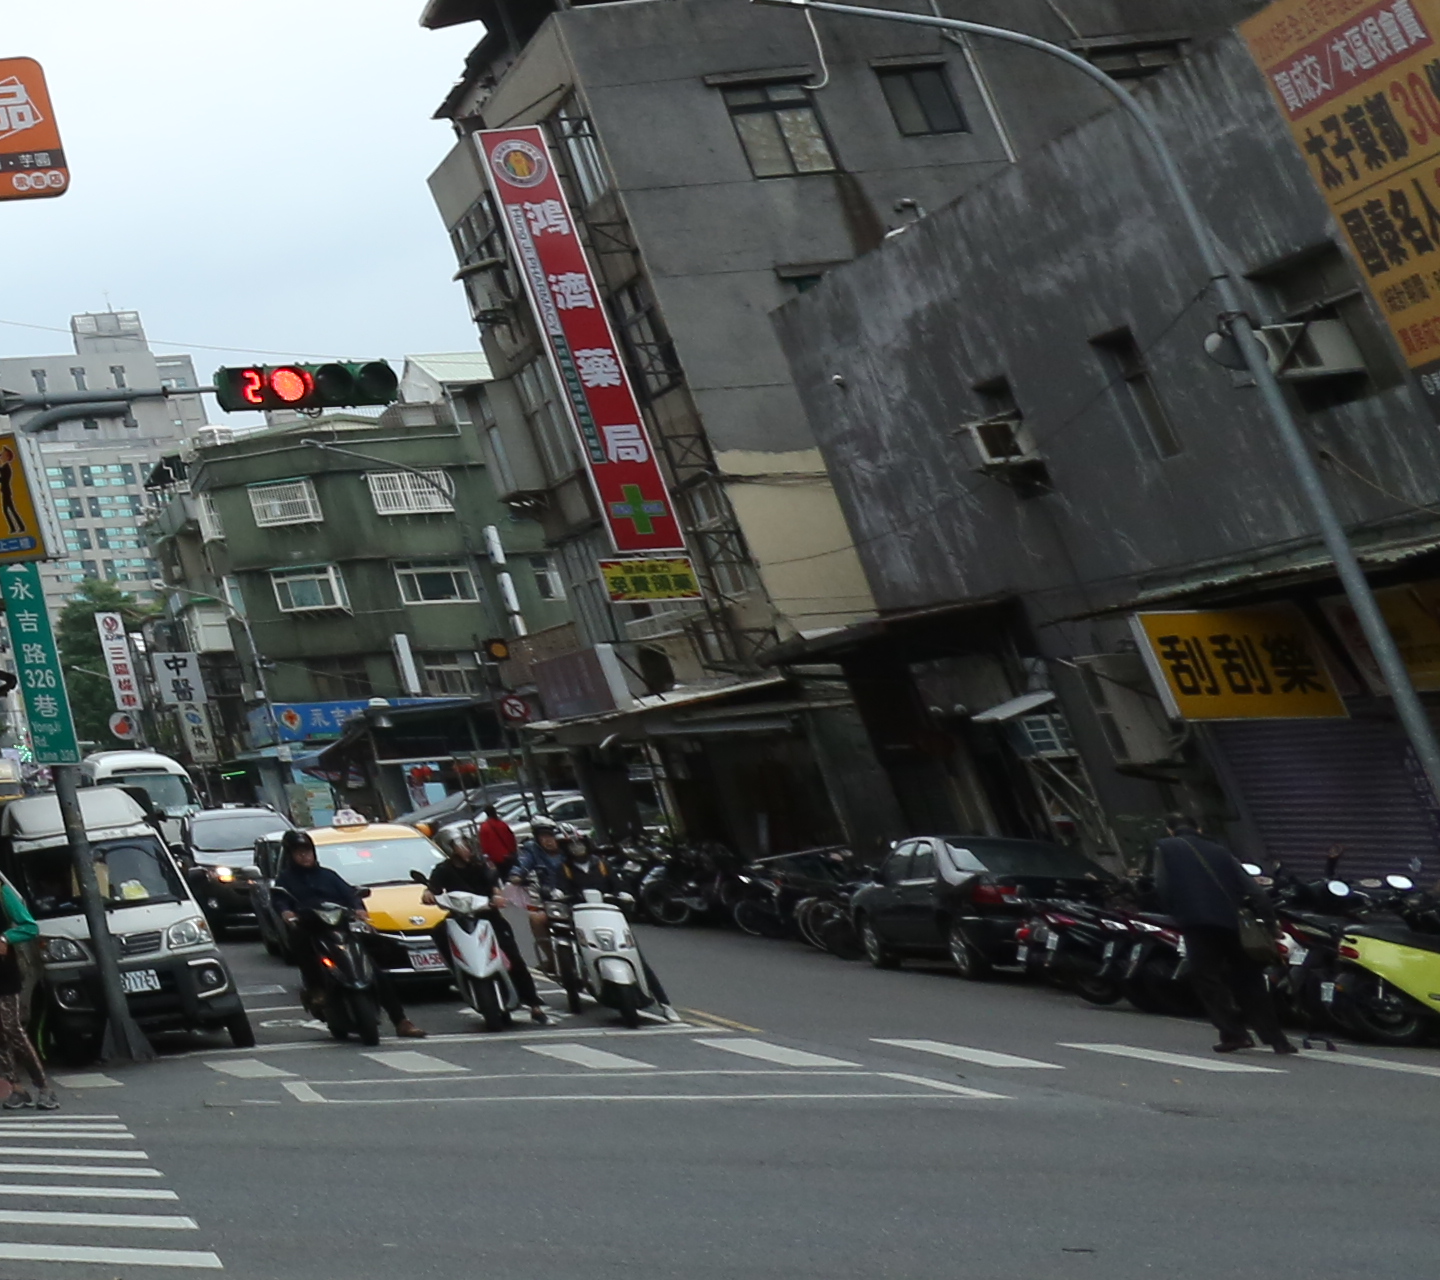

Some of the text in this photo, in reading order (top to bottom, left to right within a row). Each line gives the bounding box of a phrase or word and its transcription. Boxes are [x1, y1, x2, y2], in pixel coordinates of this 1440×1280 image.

[526, 256, 560, 332] PHARMACY
[164, 654, 195, 702] 中醫
[1158, 633, 1327, 696] 刮刮樂
